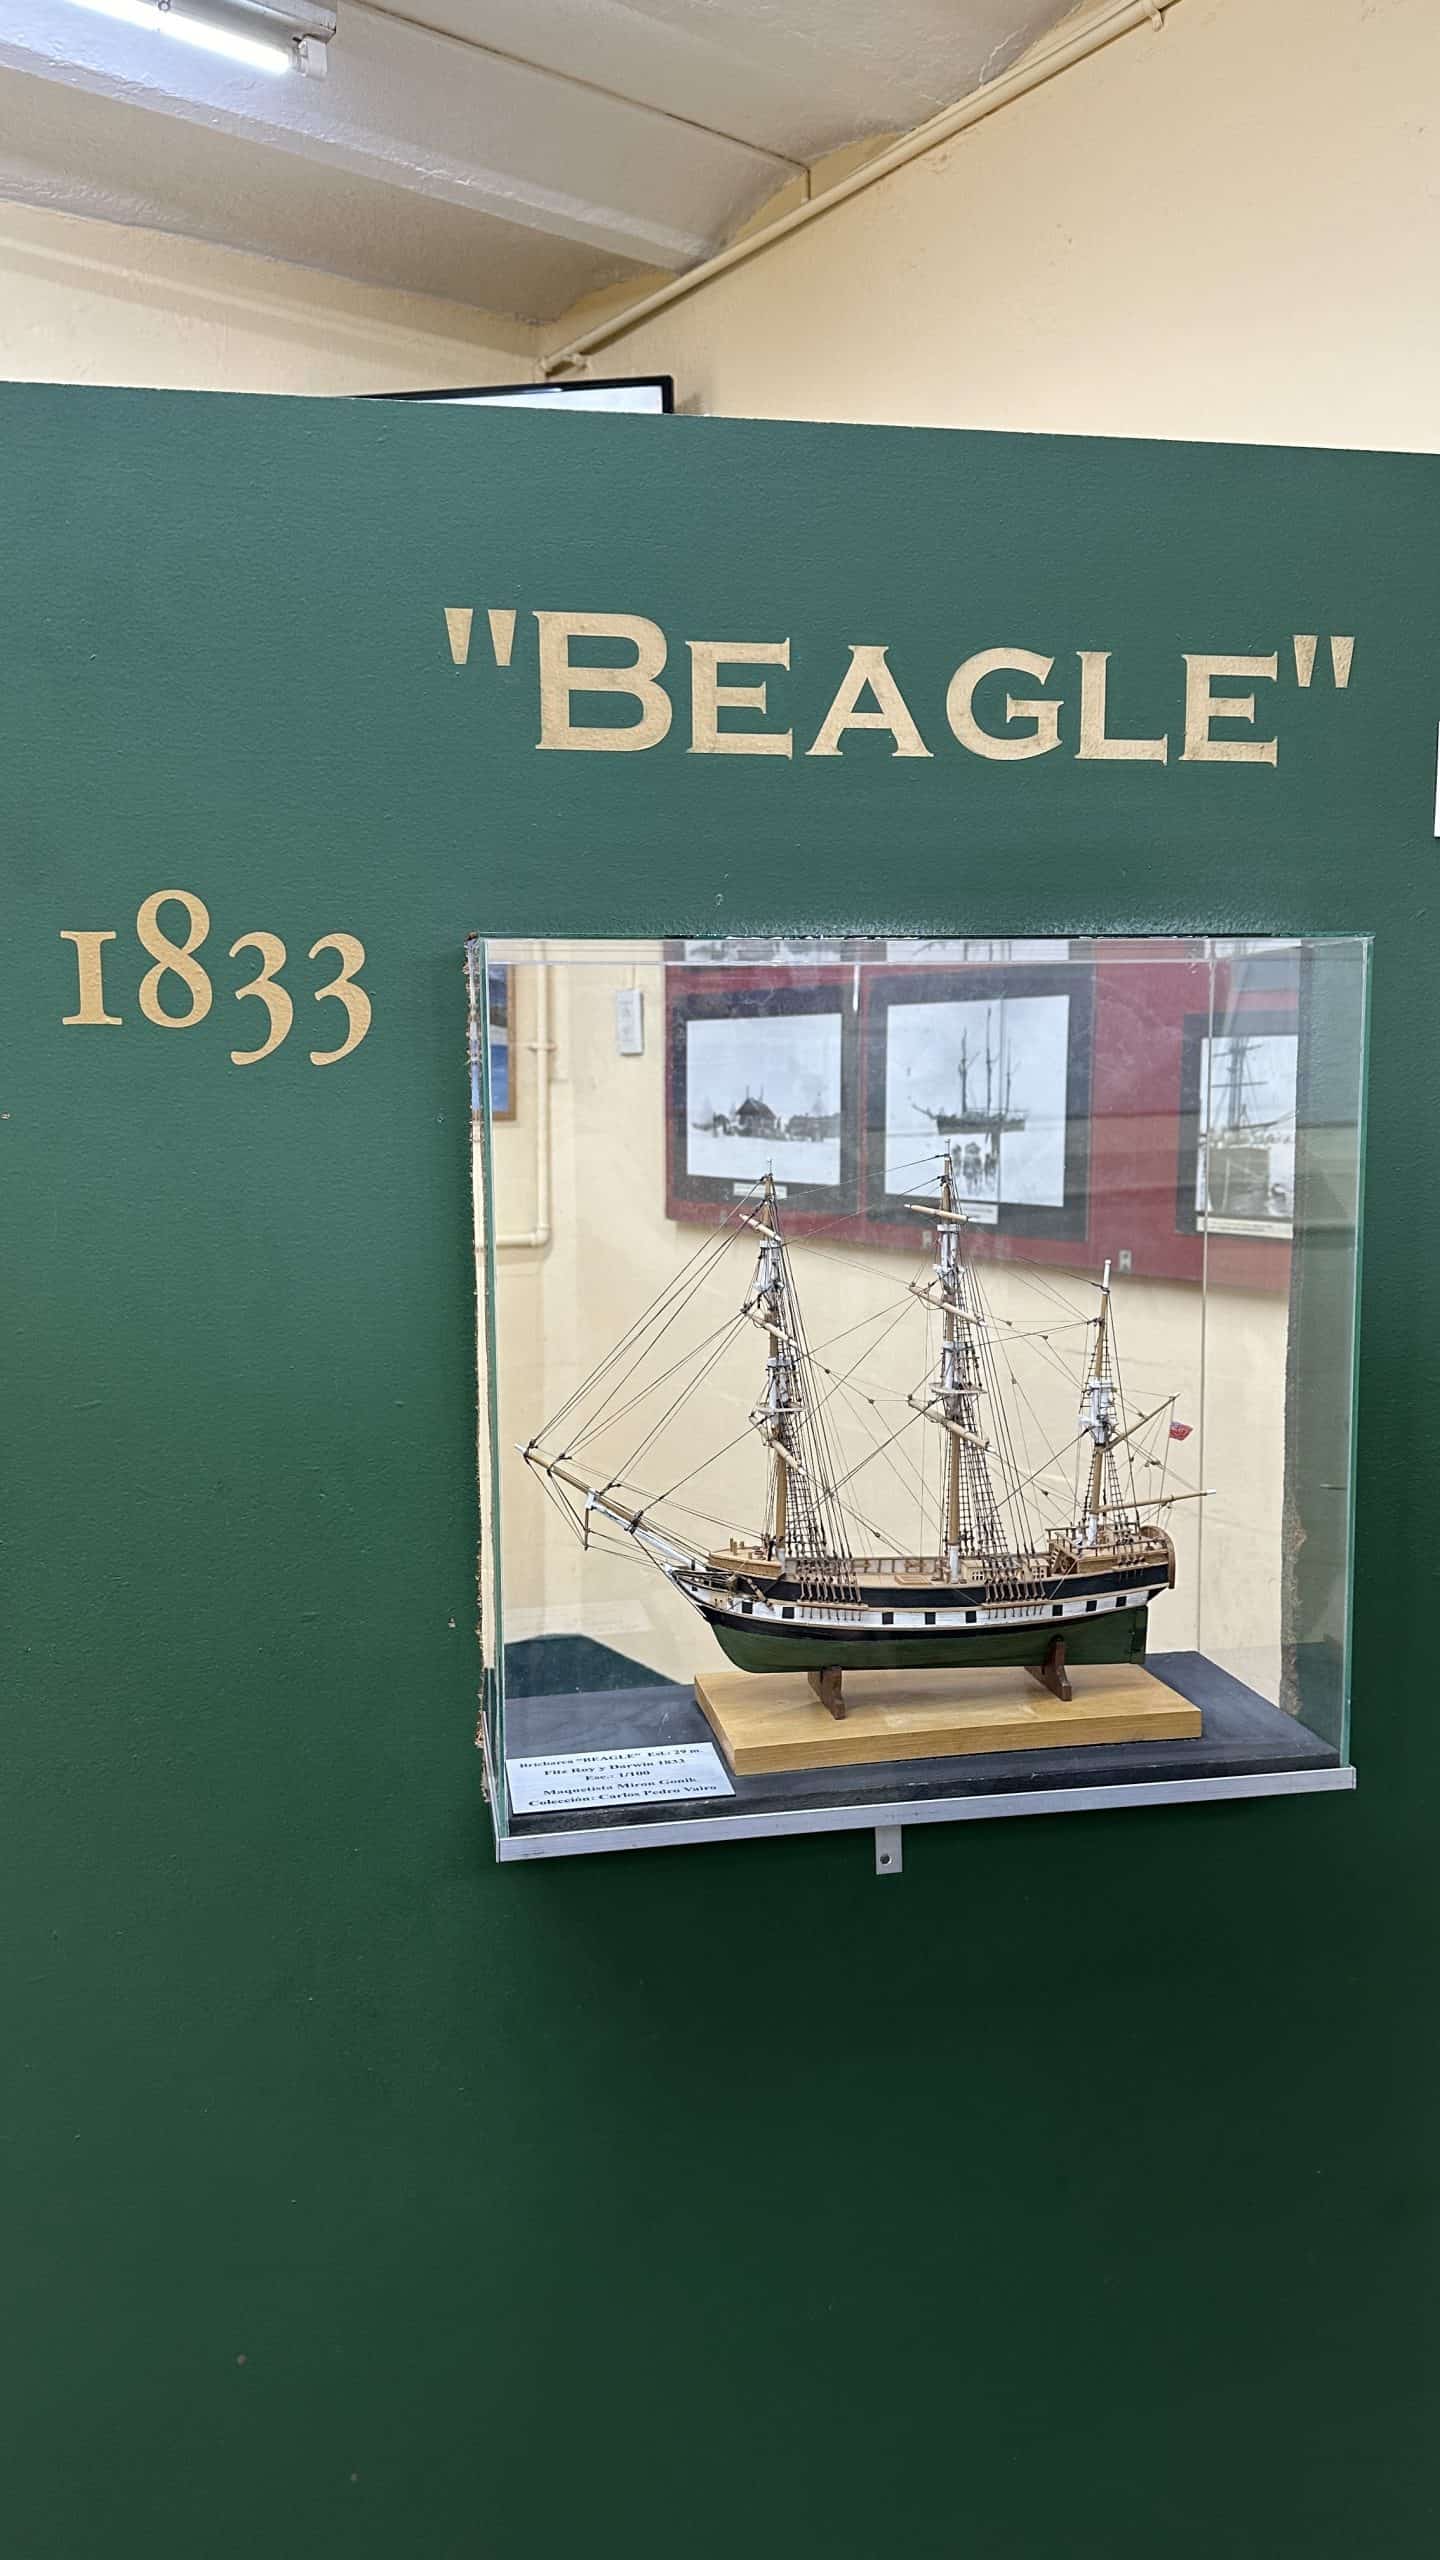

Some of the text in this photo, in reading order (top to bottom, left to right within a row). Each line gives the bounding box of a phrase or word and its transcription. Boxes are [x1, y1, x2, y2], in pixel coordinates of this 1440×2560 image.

[444, 607, 1356, 767] "BEAGLE"
[60, 889, 372, 1066] 1833
[609, 1761, 655, 1770] Darwin
[543, 1784, 614, 1796] Maquetista
[598, 1790, 641, 1802] Carlos
[643, 1787, 681, 1797] Pedro
